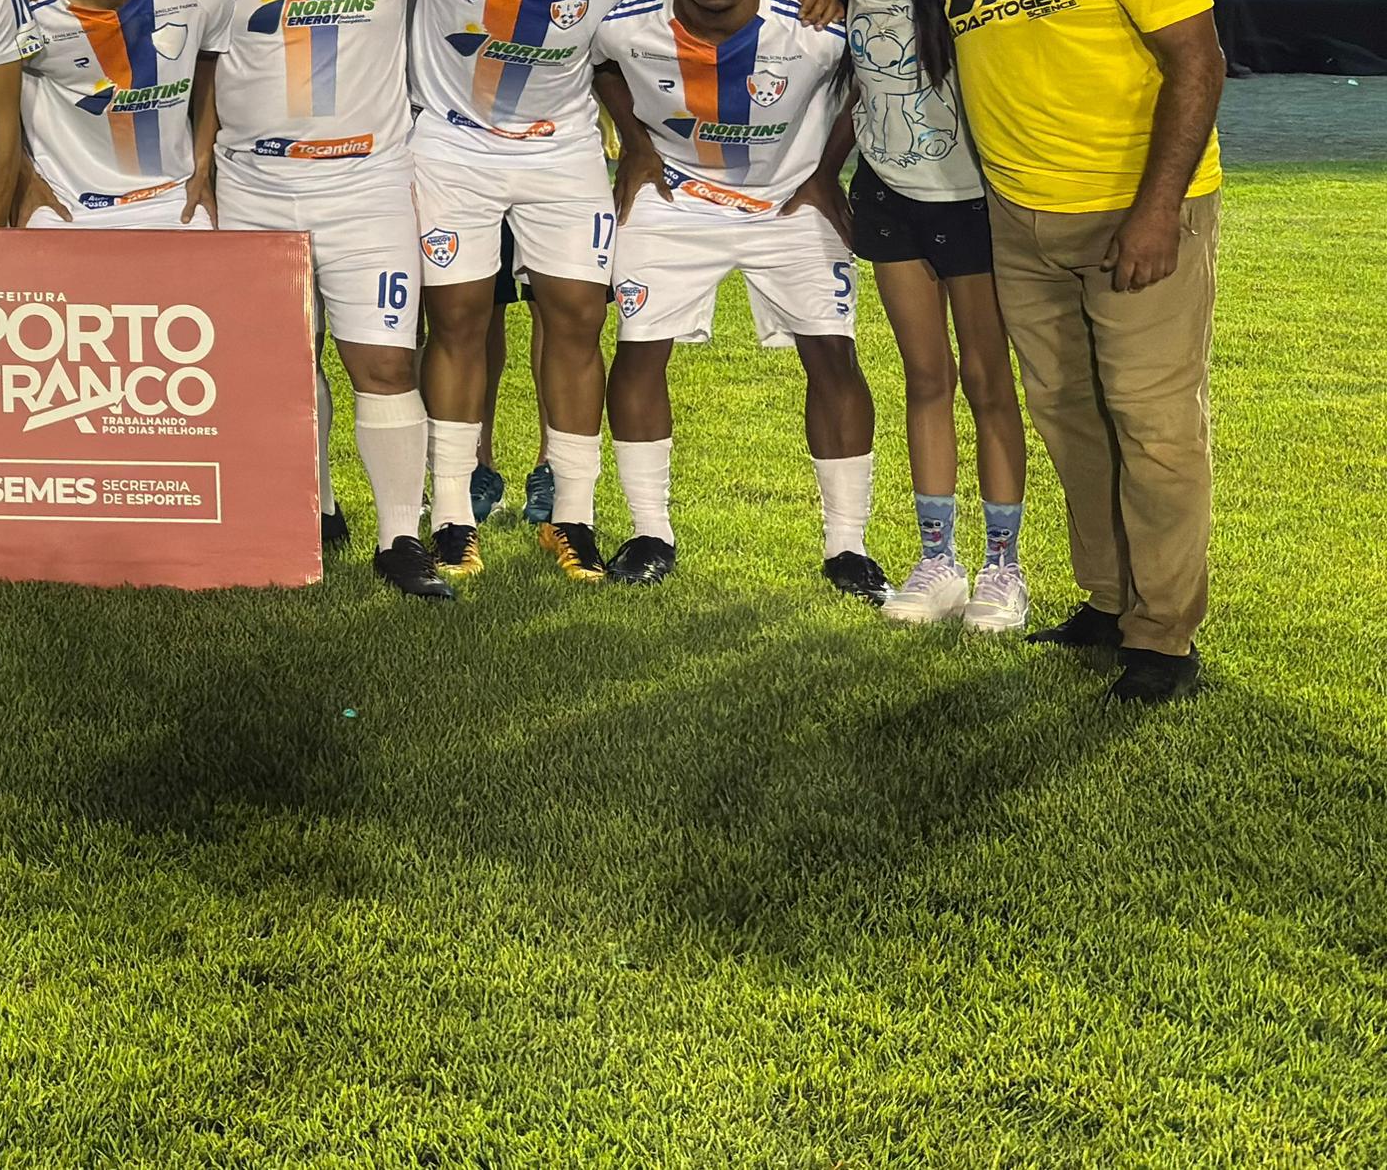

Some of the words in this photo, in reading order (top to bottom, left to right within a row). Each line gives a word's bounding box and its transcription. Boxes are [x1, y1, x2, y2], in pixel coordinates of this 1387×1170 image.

[1027, 0, 1077, 18] SCIENCE
[487, 41, 578, 60] NORTINS
[113, 78, 191, 104] NORTINS
[699, 122, 789, 136] NORTINS
[298, 140, 369, 155] Tocantins
[593, 212, 614, 250] 17
[378, 271, 408, 309] 16
[102, 416, 187, 426] TRABALHANDO
[102, 426, 126, 434] POR
[128, 426, 155, 435] DIAS
[158, 426, 218, 436] MELHORES
[102, 479, 190, 492] SECRETARIA
[103, 493, 123, 504] DE
[126, 494, 202, 506] ESPORTES
